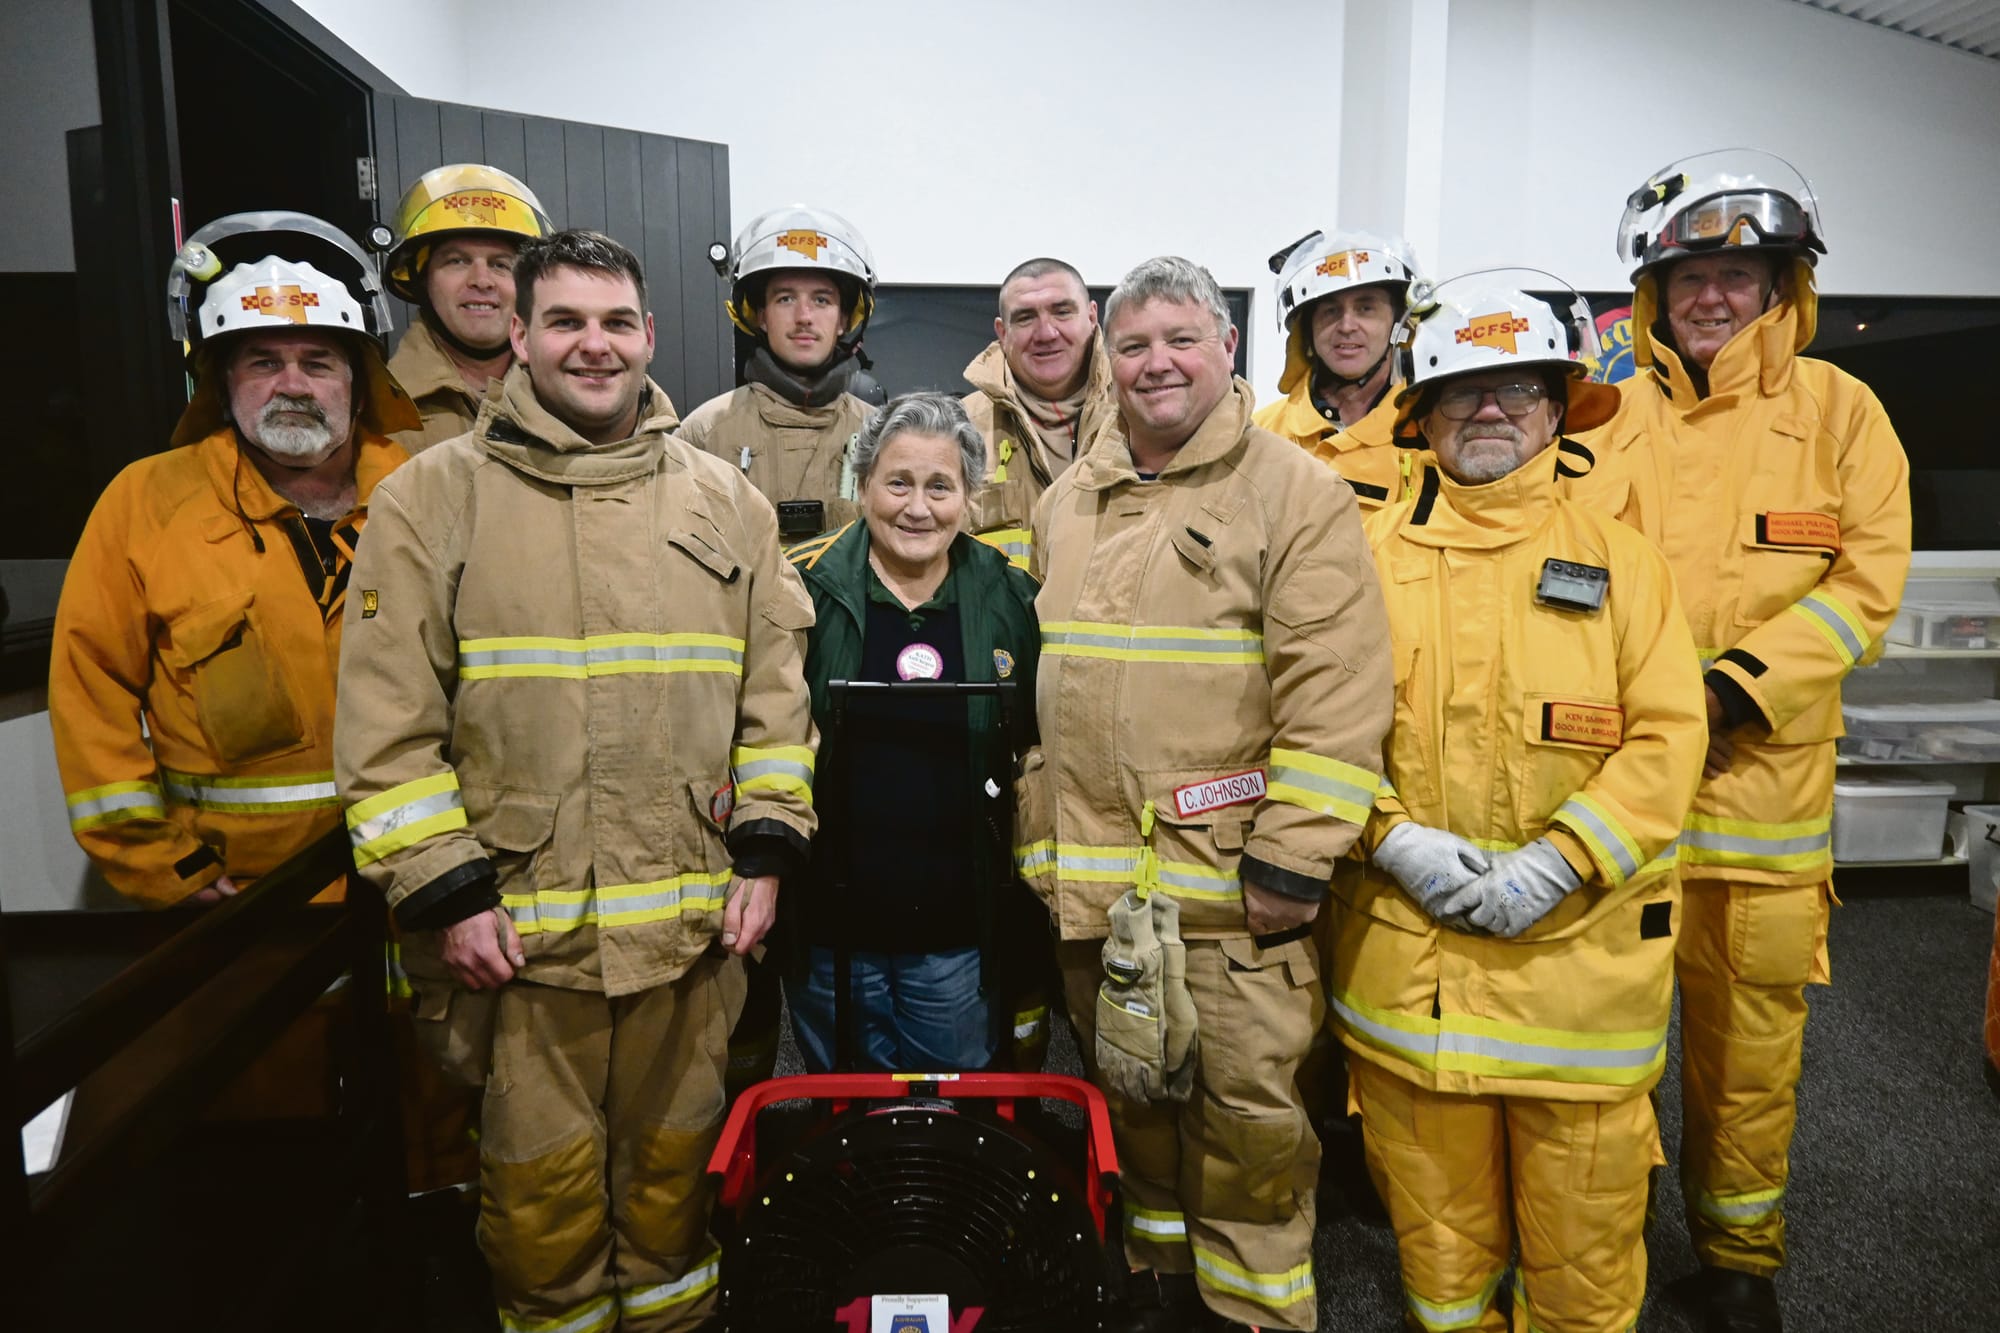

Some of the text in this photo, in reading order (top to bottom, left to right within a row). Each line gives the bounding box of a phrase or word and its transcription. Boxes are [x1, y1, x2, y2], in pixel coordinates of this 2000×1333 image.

[459, 196, 491, 207] CFS
[790, 236, 814, 246] CFS
[1328, 257, 1350, 271] CF
[260, 294, 300, 307] CFS
[1472, 322, 1511, 339] CFS
[1565, 712, 1582, 722] KEN
[1184, 775, 1260, 809] C. JOHNSON
